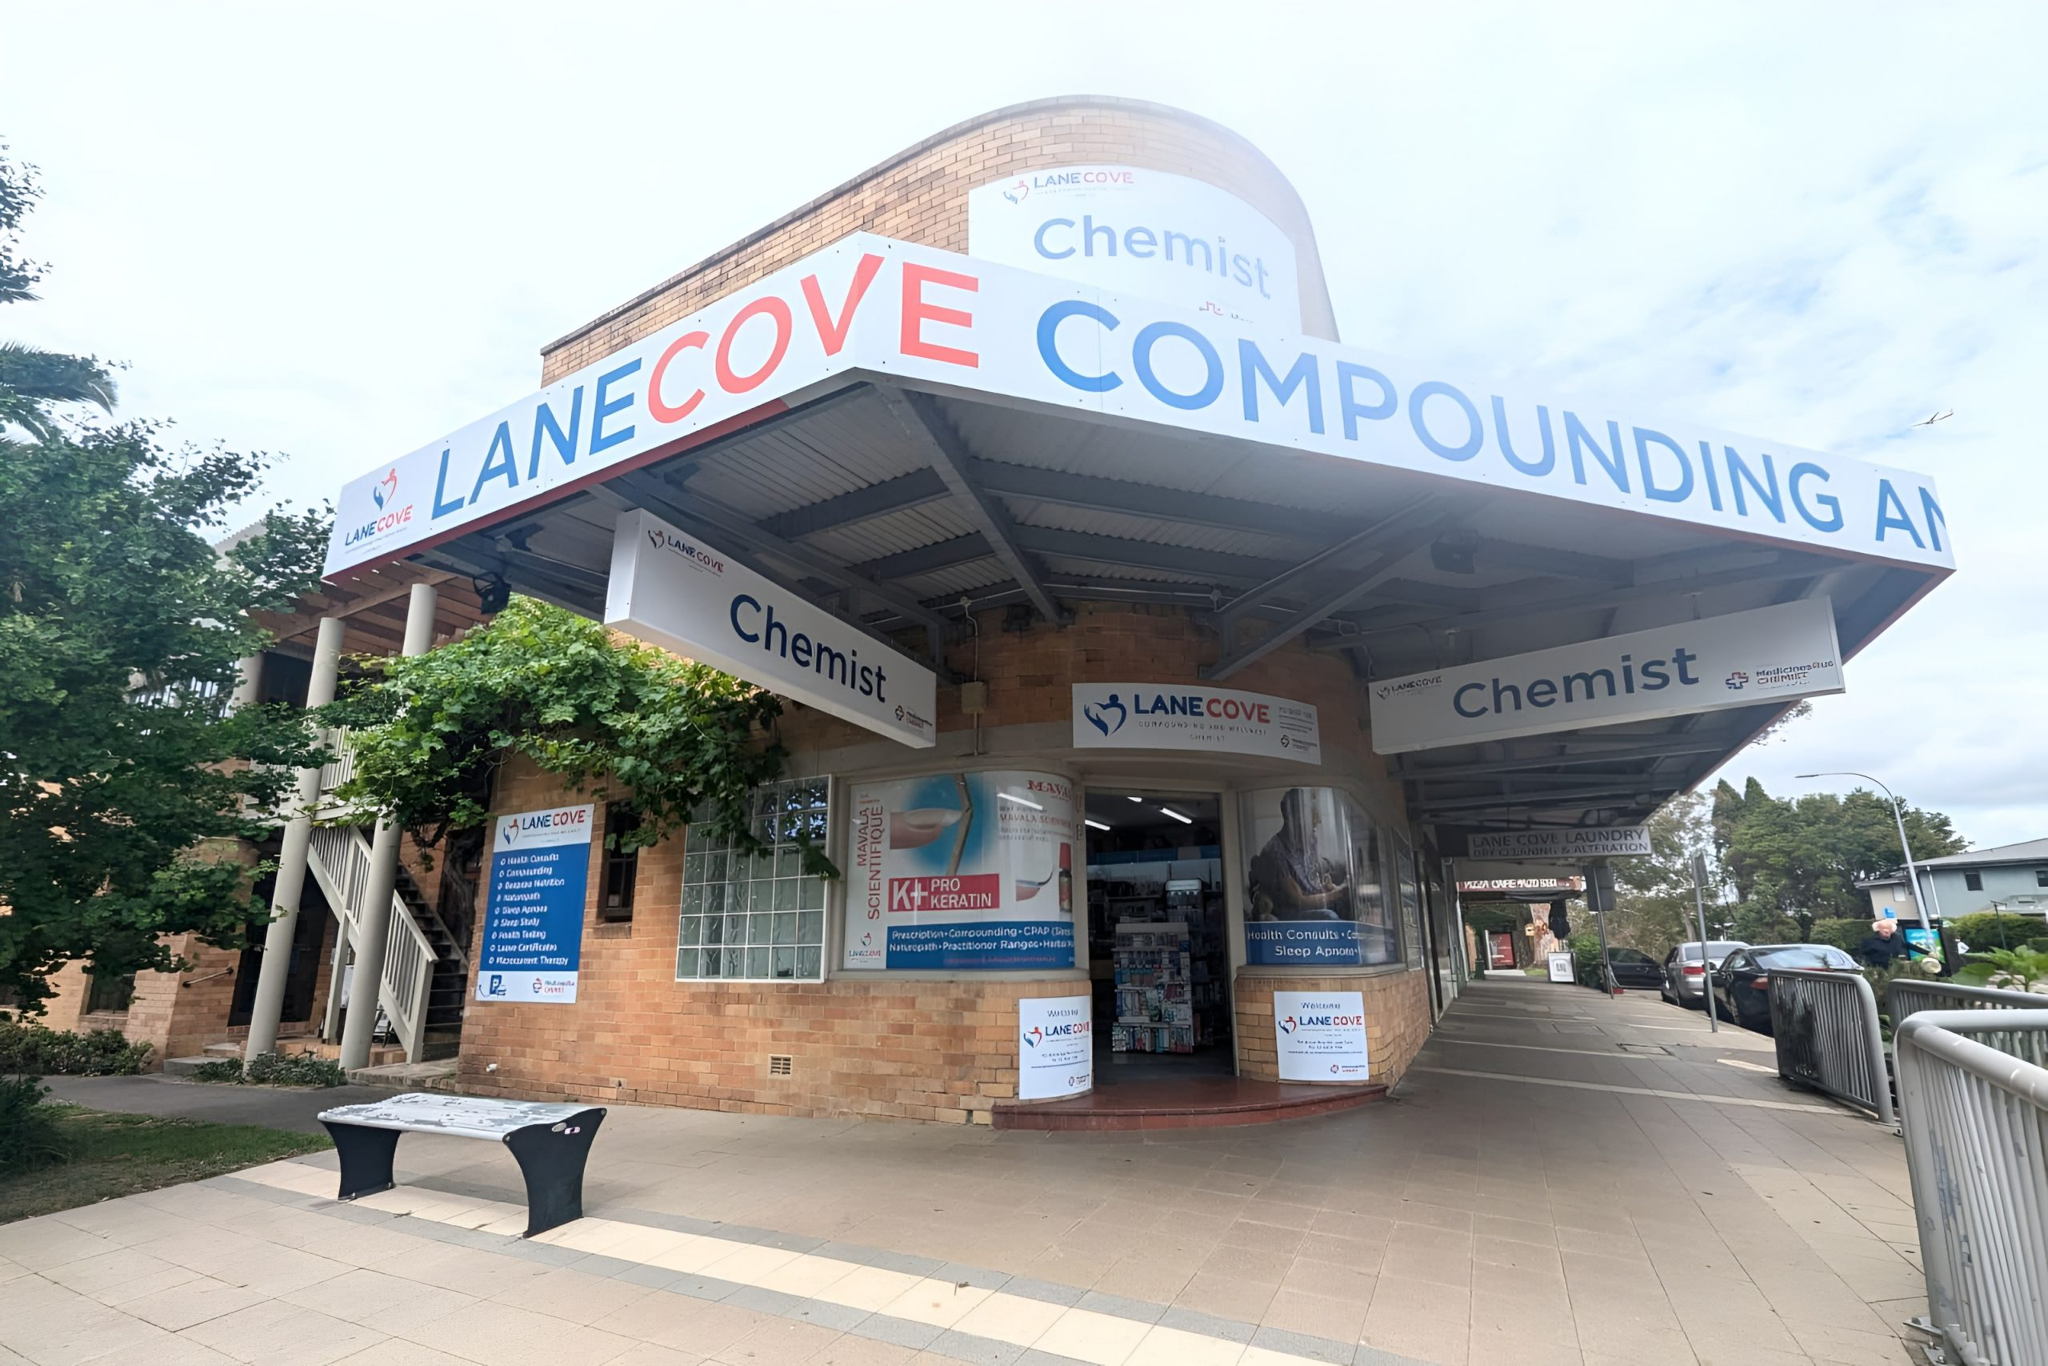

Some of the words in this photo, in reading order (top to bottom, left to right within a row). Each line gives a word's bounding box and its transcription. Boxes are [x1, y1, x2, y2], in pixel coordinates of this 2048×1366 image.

[1033, 214, 1271, 300] Chemist
[1036, 299, 1843, 533] COMPOUNDING
[729, 593, 887, 703] Chemist
[1452, 647, 1701, 719] Chemist
[857, 807, 870, 867] MAVALA
[867, 805, 886, 920] SCIENTIFIQUE
[1472, 833, 1512, 849] LANE
[1565, 828, 1645, 844] LAUNDRY
[930, 878, 961, 893] PRO
[930, 893, 992, 909] KERATIN
[1275, 945, 1311, 957] Sleep
